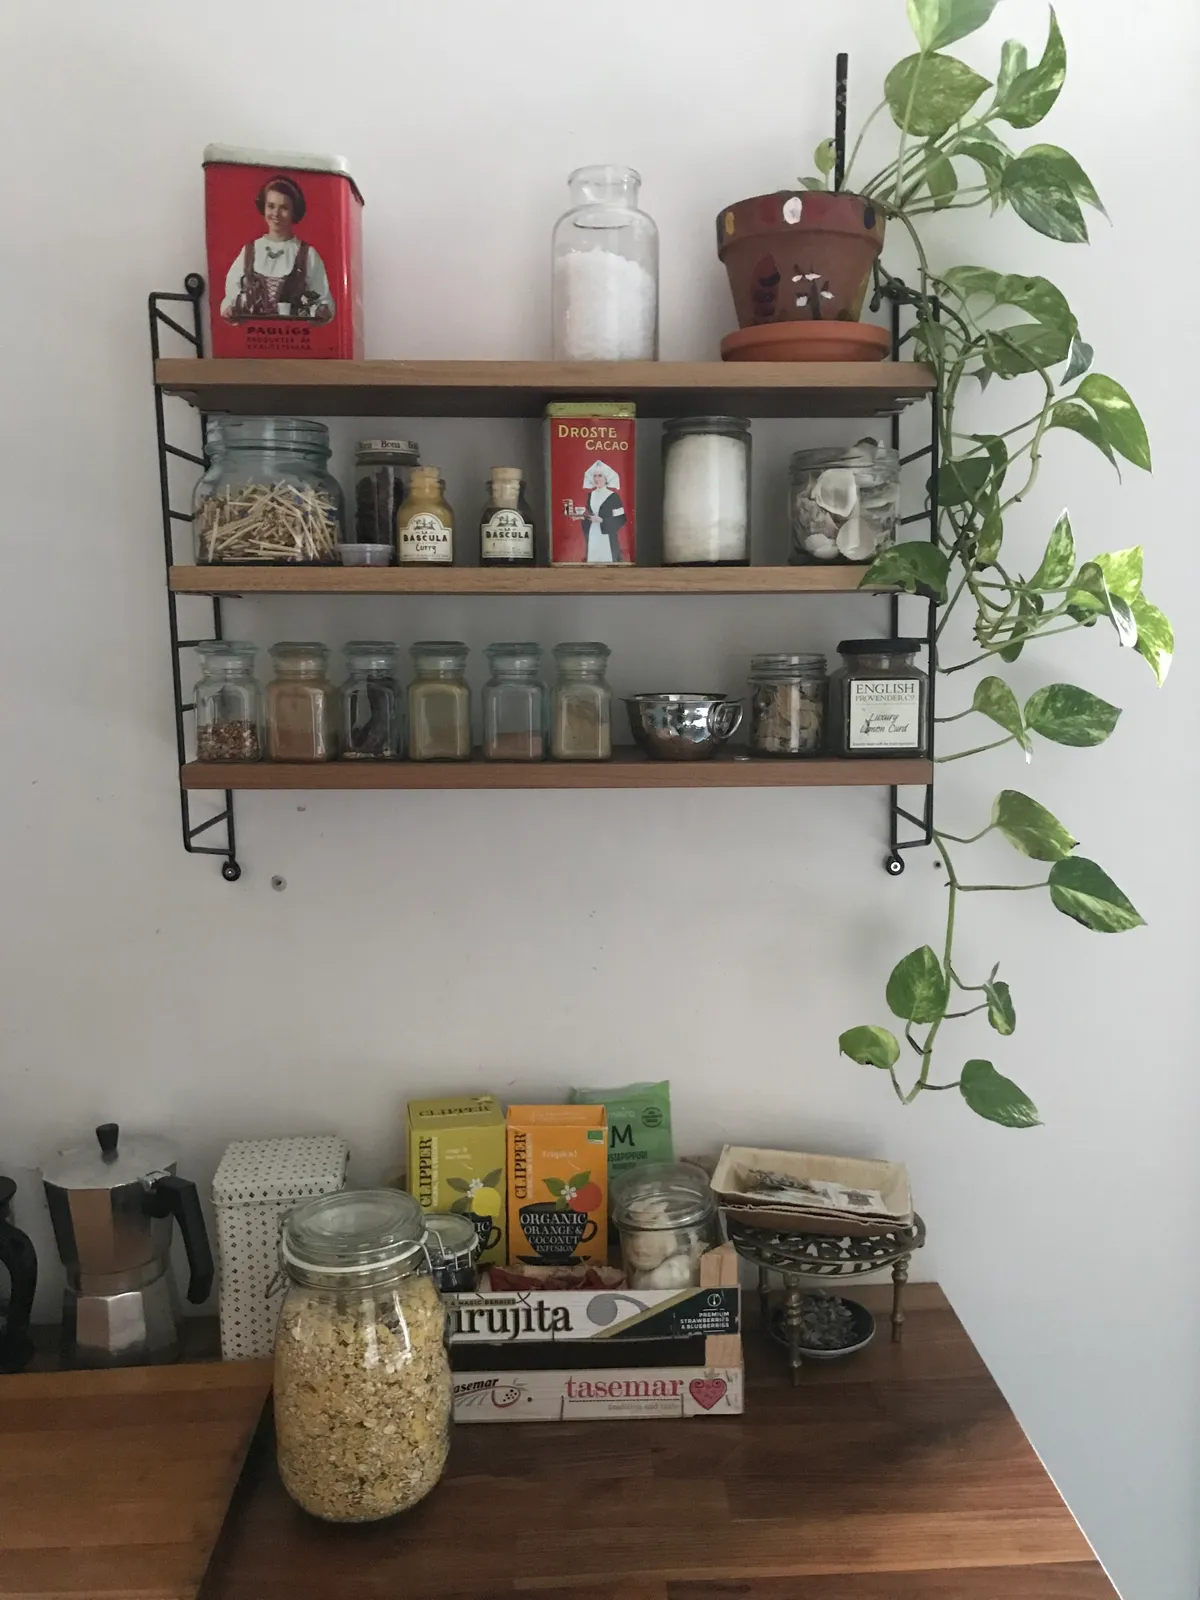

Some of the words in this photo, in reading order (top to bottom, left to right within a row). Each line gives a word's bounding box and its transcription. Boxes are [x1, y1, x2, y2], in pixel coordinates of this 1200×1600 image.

[558, 424, 617, 438] DROSTE
[381, 440, 401, 449] Bona
[585, 439, 629, 451] CACAO
[415, 543, 437, 554] Curry
[856, 683, 915, 694] ENGLISH
[855, 694, 904, 702] PROVENDER
[868, 712, 900, 724] Luxury
[888, 723, 910, 733] Curd
[419, 1105, 491, 1116] CLIPPER
[610, 1124, 636, 1148] M
[607, 1150, 648, 1162] STAPIPPURI
[514, 1132, 527, 1200] CLIPPER
[419, 1138, 433, 1208] CLIPPER
[520, 1213, 587, 1225] ORGANIC
[523, 1225, 575, 1235] ORANGE
[575, 1225, 583, 1235] &
[528, 1235, 580, 1245] COCONUT
[446, 1299, 574, 1340] irujita
[686, 1322, 730, 1330] BLUEBERRIES
[453, 1377, 500, 1394] asemar
[565, 1375, 684, 1399] tasemar
